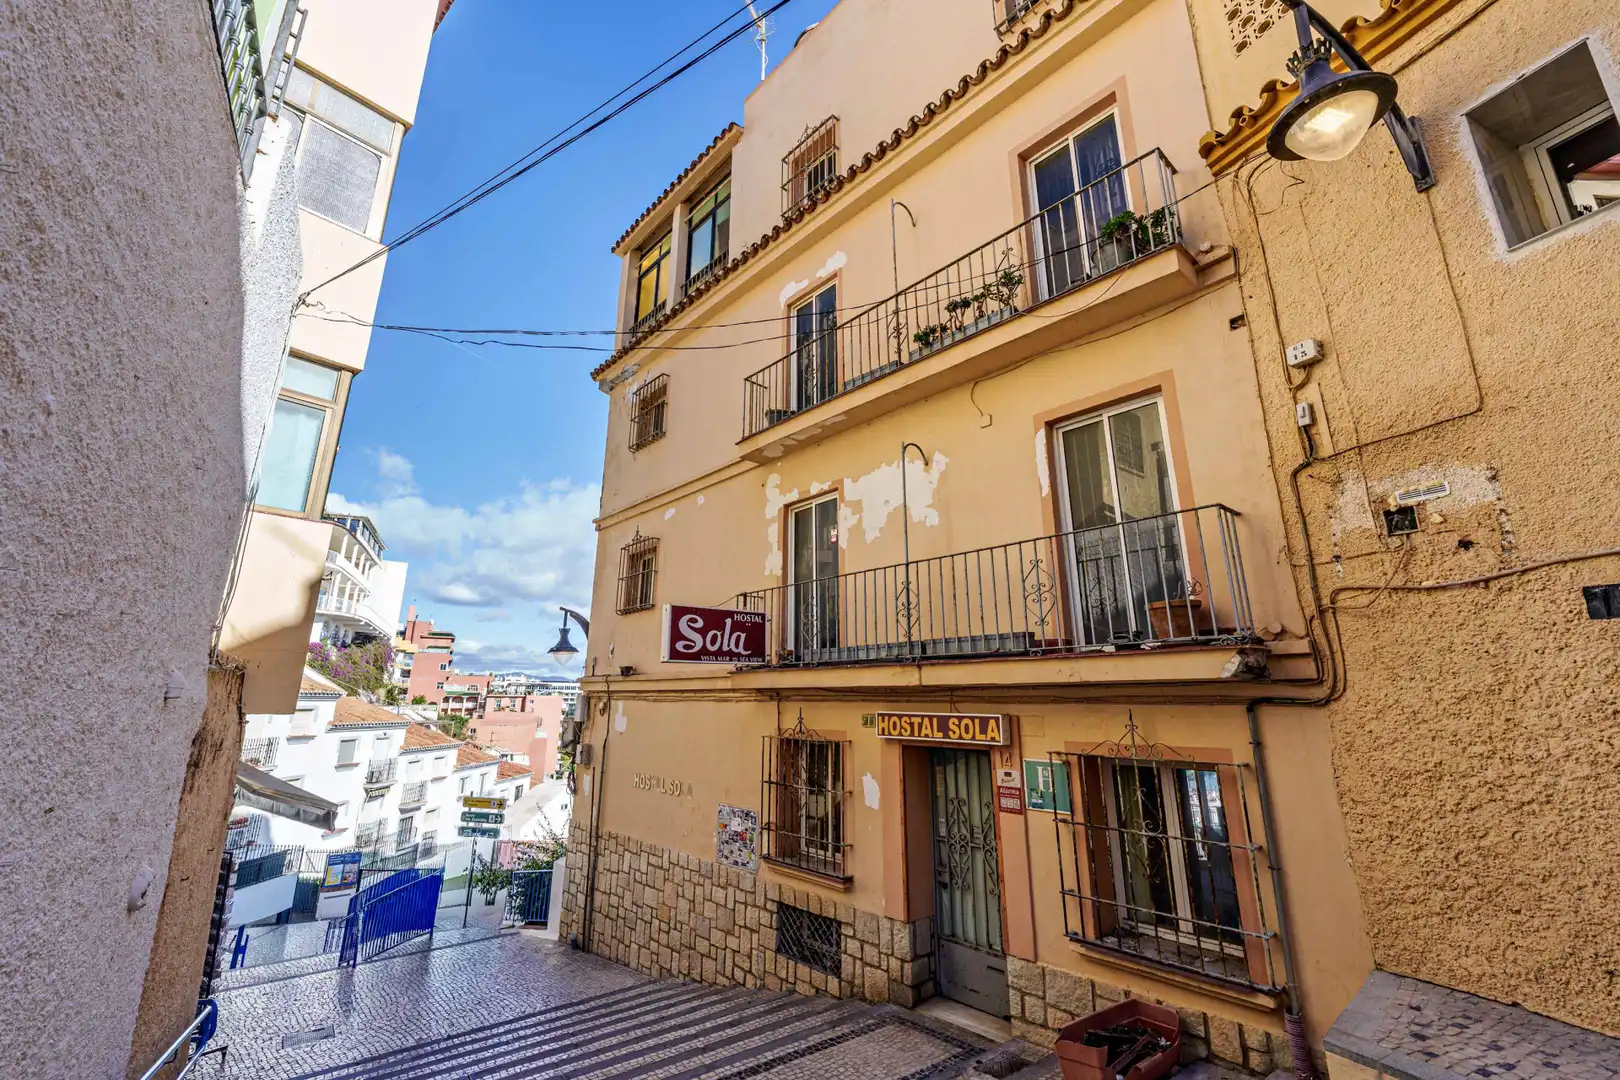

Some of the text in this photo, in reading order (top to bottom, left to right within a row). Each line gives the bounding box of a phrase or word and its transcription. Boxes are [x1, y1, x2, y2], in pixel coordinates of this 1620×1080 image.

[734, 613, 763, 623] HOSTAL
[675, 614, 752, 655] Sola
[878, 716, 943, 738] HOSTAL
[948, 717, 1001, 741] SOLA
[633, 773, 667, 794] HOSL
[1000, 787, 1020, 795] Alarma
